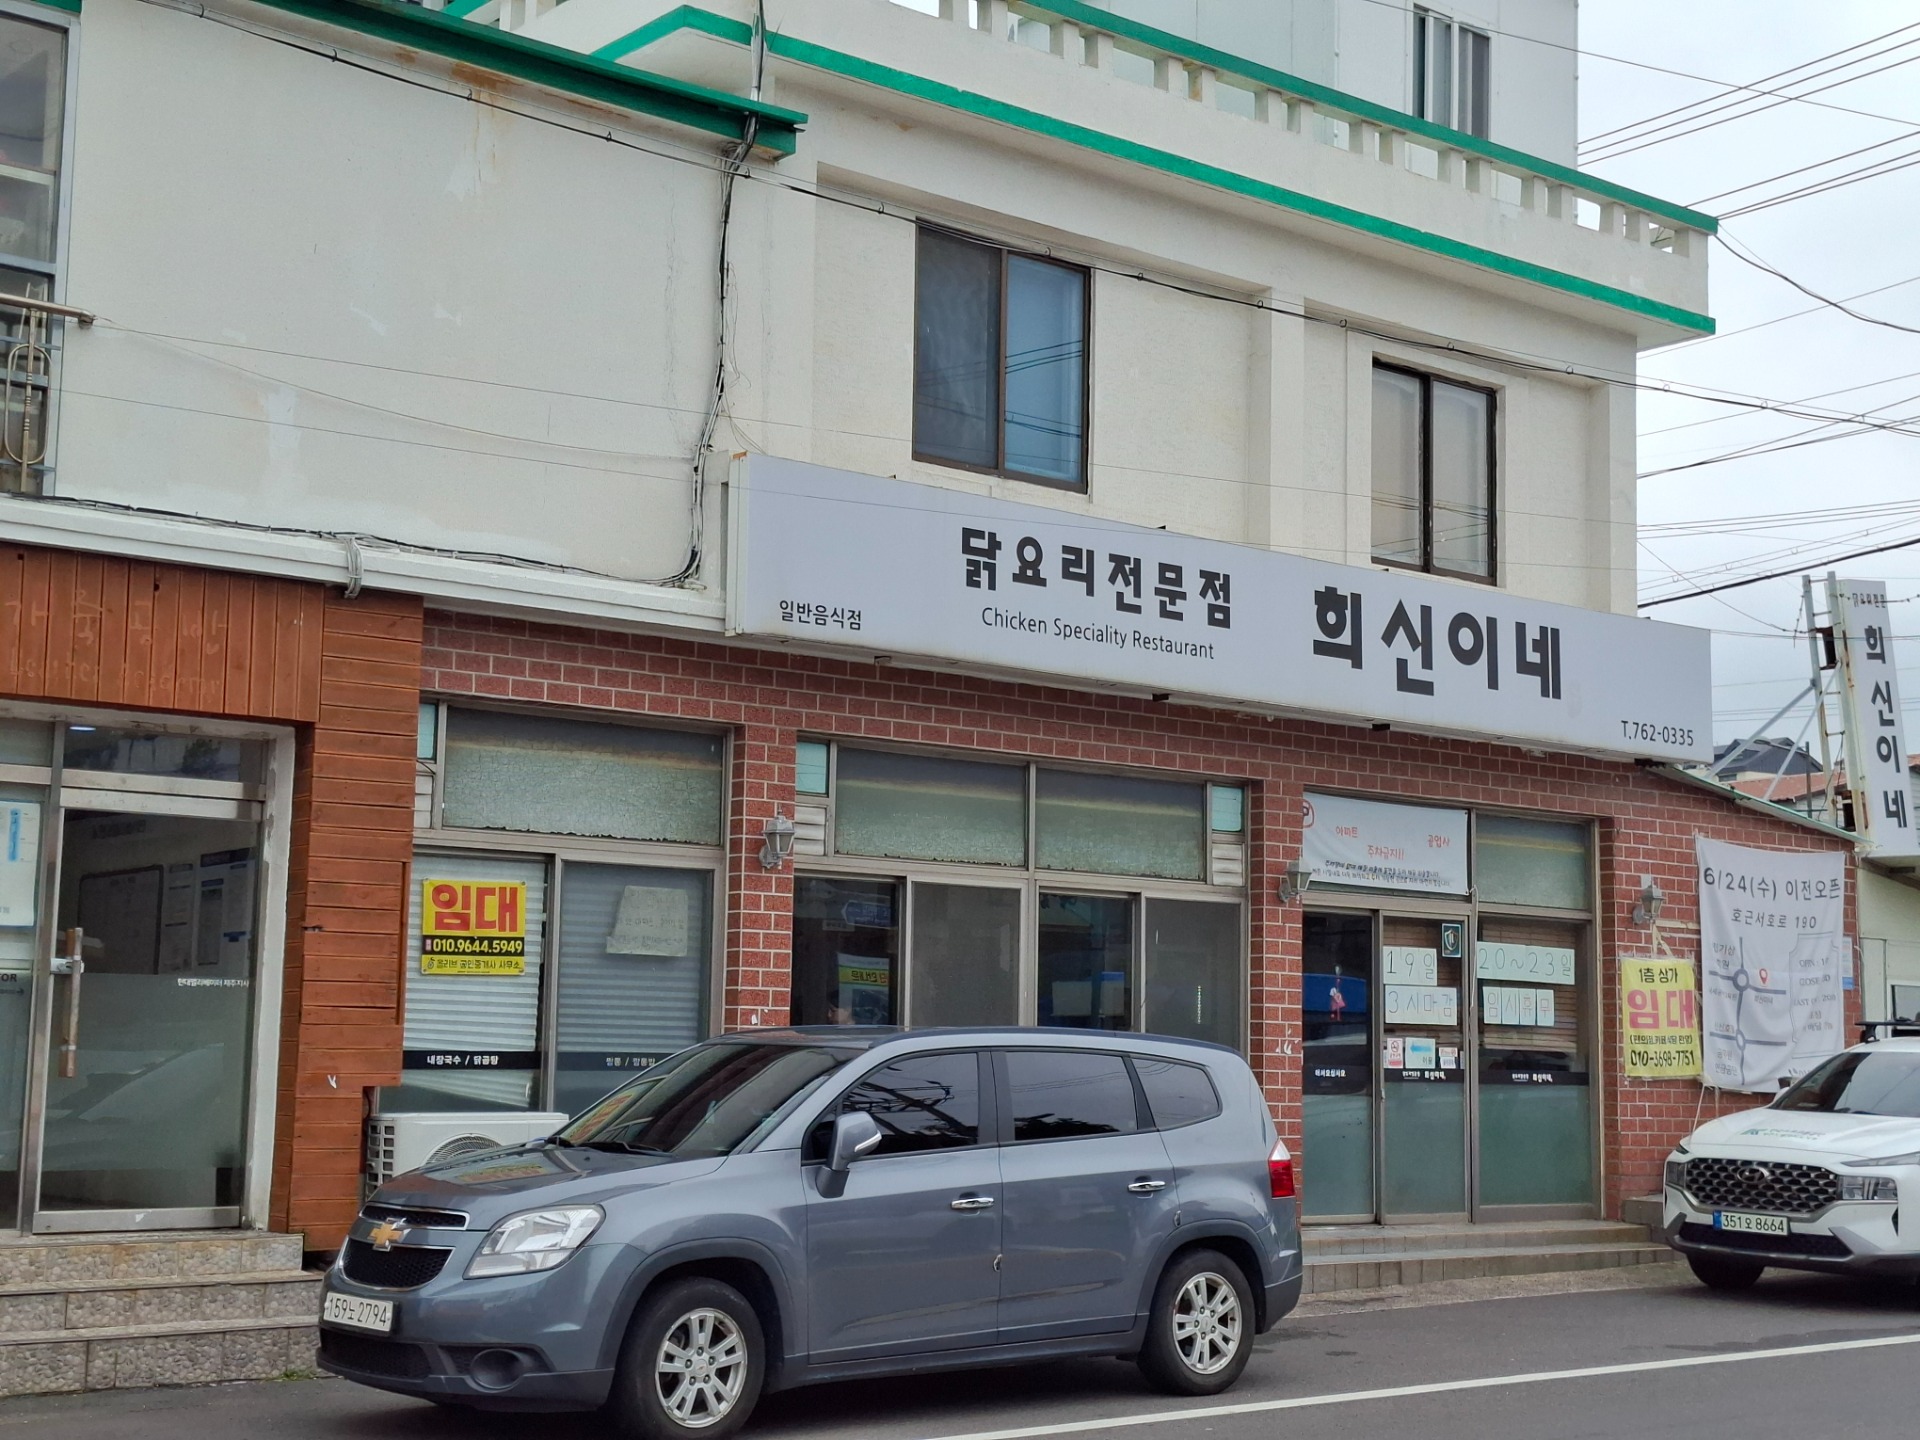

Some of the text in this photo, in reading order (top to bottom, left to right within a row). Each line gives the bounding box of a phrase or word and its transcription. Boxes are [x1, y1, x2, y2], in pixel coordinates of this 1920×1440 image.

[961, 526, 1231, 629] 닭요리전문점
[778, 600, 862, 631] 일반음식점
[981, 607, 1215, 660] Chicken Speciality Restaurant
[1313, 585, 1562, 700] 희신이네
[1621, 720, 1695, 747] T.762-0335
[1865, 625, 1908, 828] 희신이네
[1335, 826, 1358, 839] 아파트
[1703, 867, 1841, 901] 6/24(수) 이전오픈
[431, 884, 519, 933] 임대
[1731, 908, 1817, 929] 호근서호로 190
[433, 938, 523, 954] 010.9644.5949
[0, 973, 17, 982] OR
[499, 959, 520, 969] 사무소
[1639, 967, 1678, 983] 1층 상가
[1487, 991, 1551, 1018] 임시휴무
[1627, 989, 1694, 1029] 임대
[427, 1055, 461, 1065] 내장국수
[1630, 1049, 1695, 1067] 010-3698-7751
[1723, 1214, 1784, 1233] 351오 8664
[329, 1296, 387, 1327] 159노 2794
